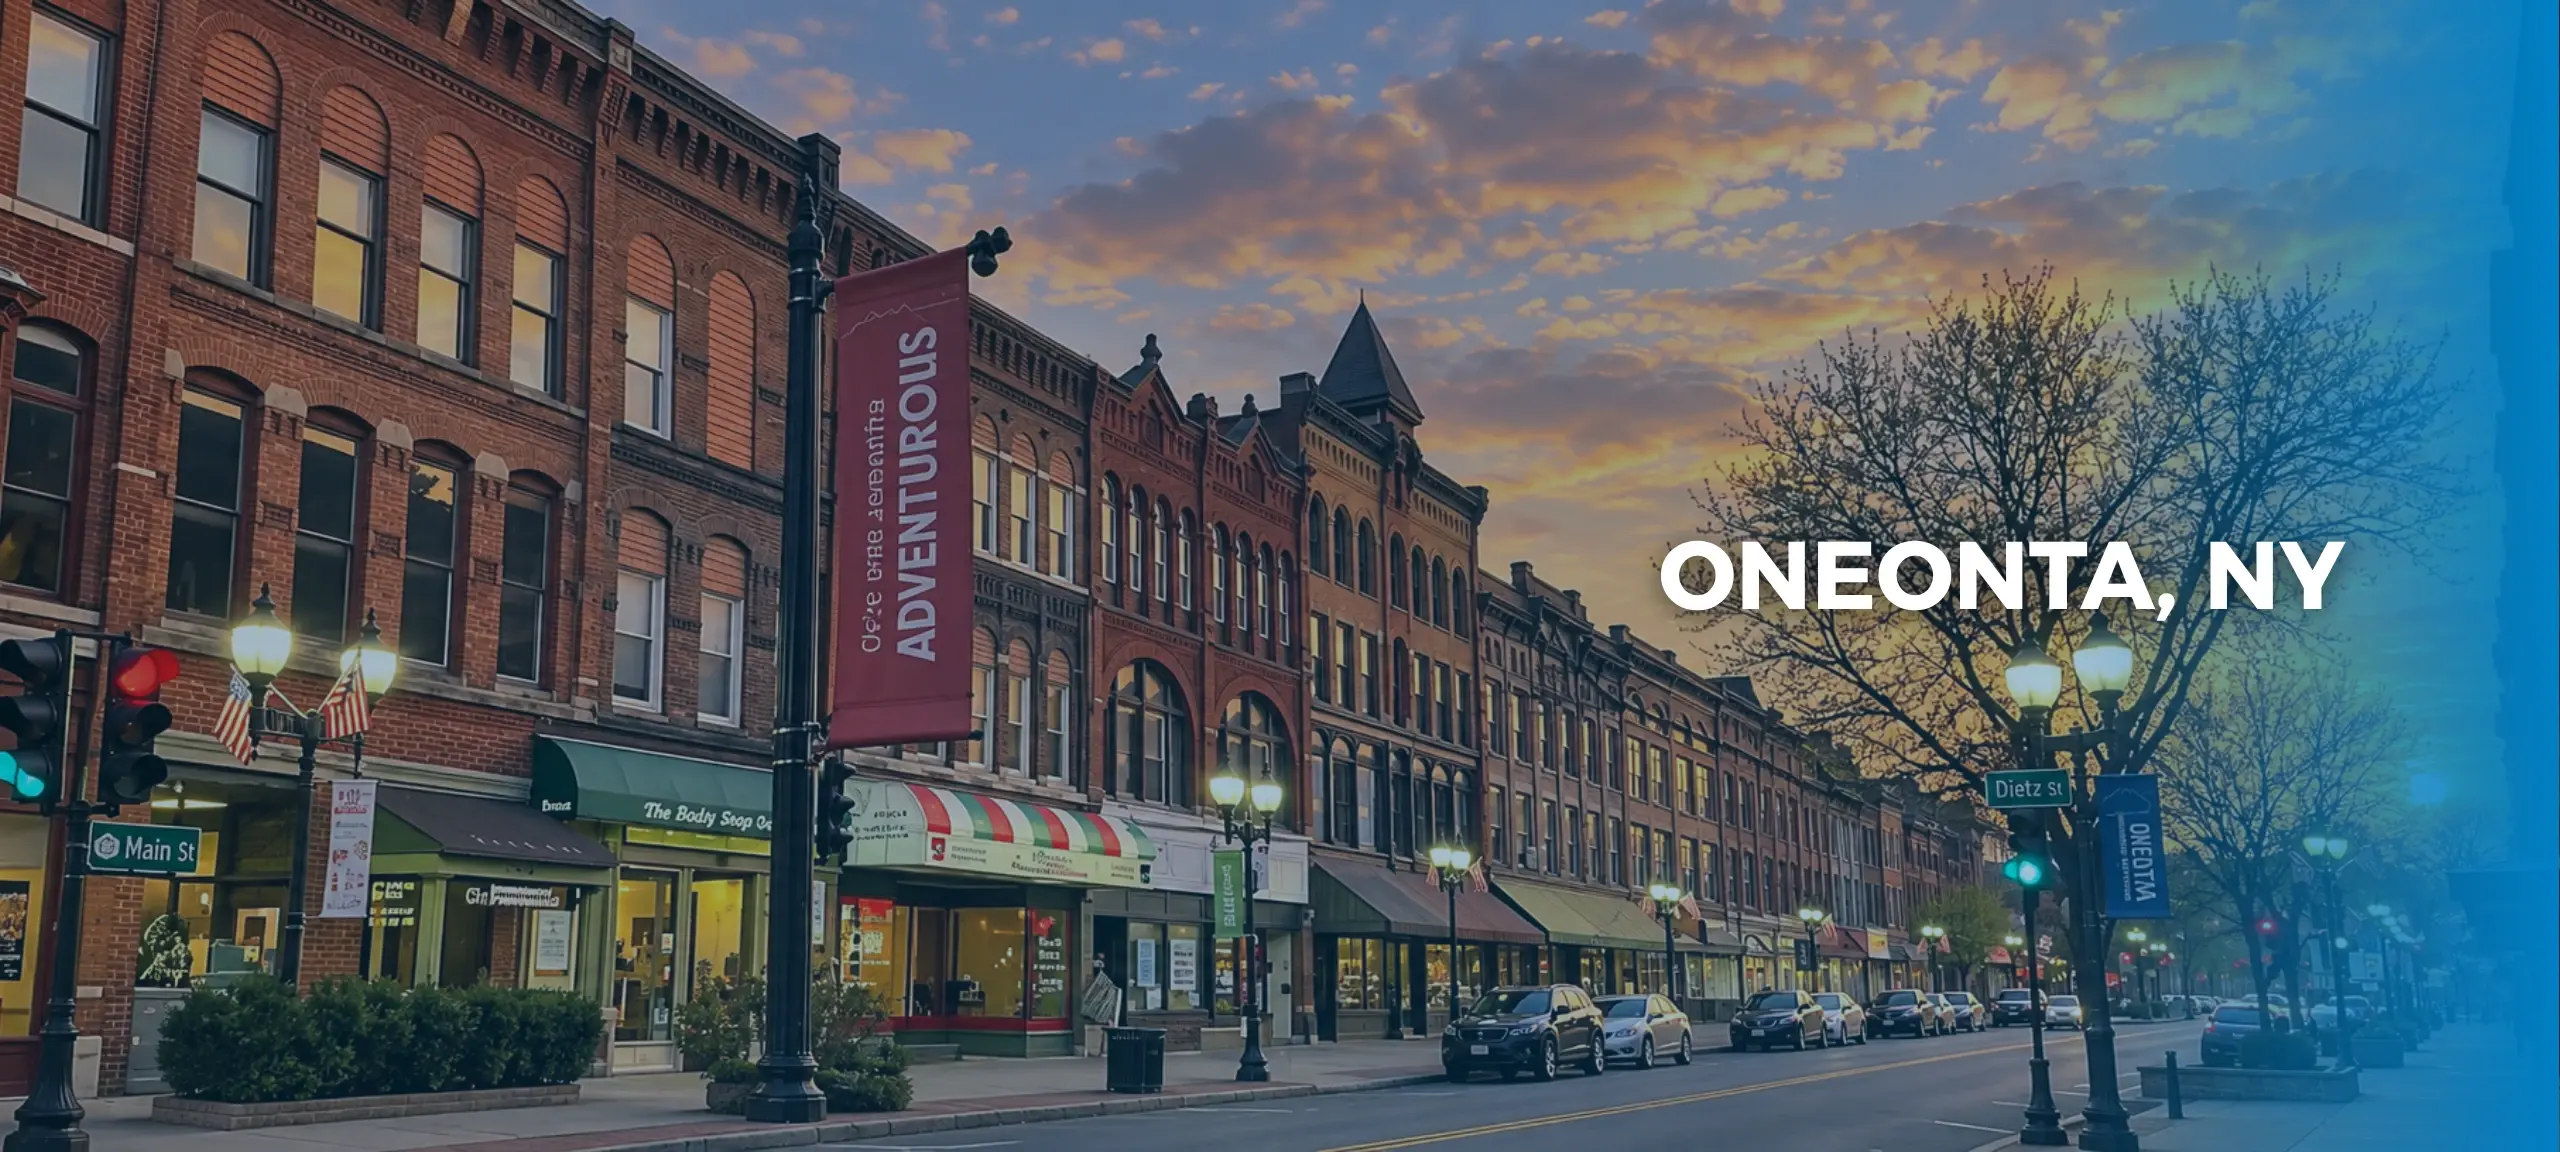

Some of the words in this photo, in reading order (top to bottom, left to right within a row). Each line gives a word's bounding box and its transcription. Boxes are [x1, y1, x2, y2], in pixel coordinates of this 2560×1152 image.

[897, 326, 937, 662] ADVENTUROUS
[1996, 780, 2042, 798] Dietz
[644, 802, 672, 820] The
[125, 836, 171, 860] Main
[178, 841, 195, 862] St
